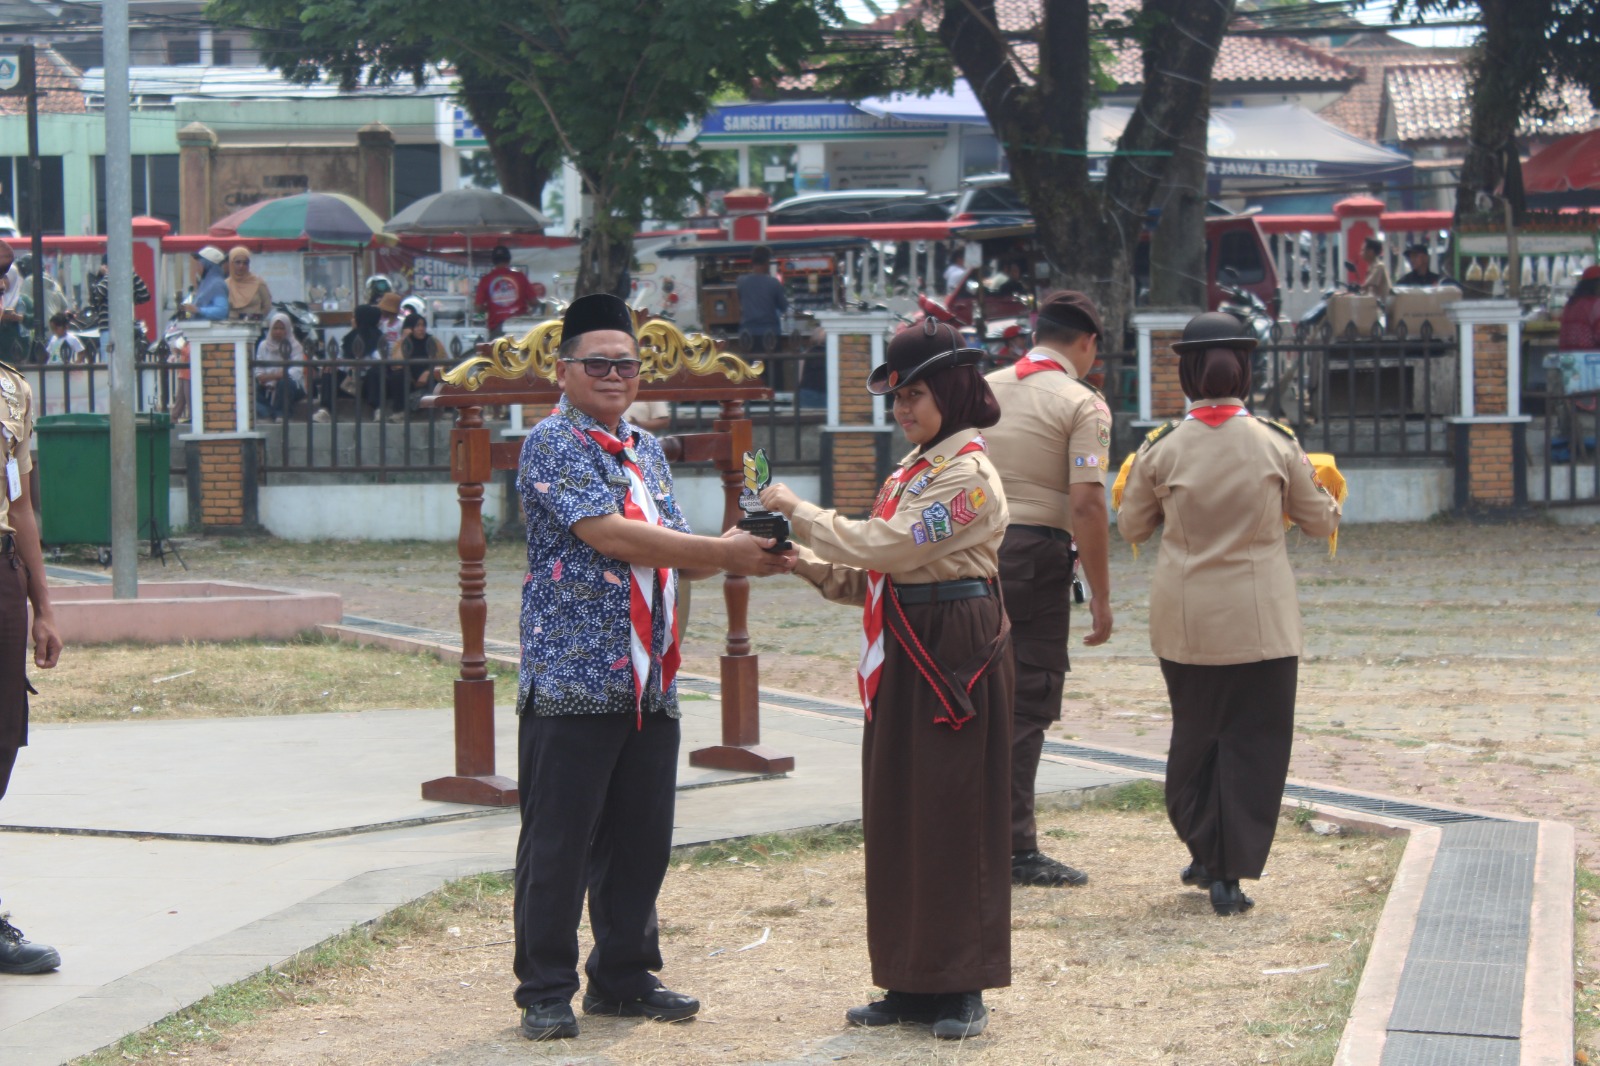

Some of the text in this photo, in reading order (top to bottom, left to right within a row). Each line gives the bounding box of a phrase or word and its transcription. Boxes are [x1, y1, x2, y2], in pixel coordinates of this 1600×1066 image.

[723, 115, 773, 131] SAMSAT
[774, 115, 837, 130] PEMBANTU
[1220, 162, 1262, 175] JAWA
[1266, 163, 1318, 176] BARAT
